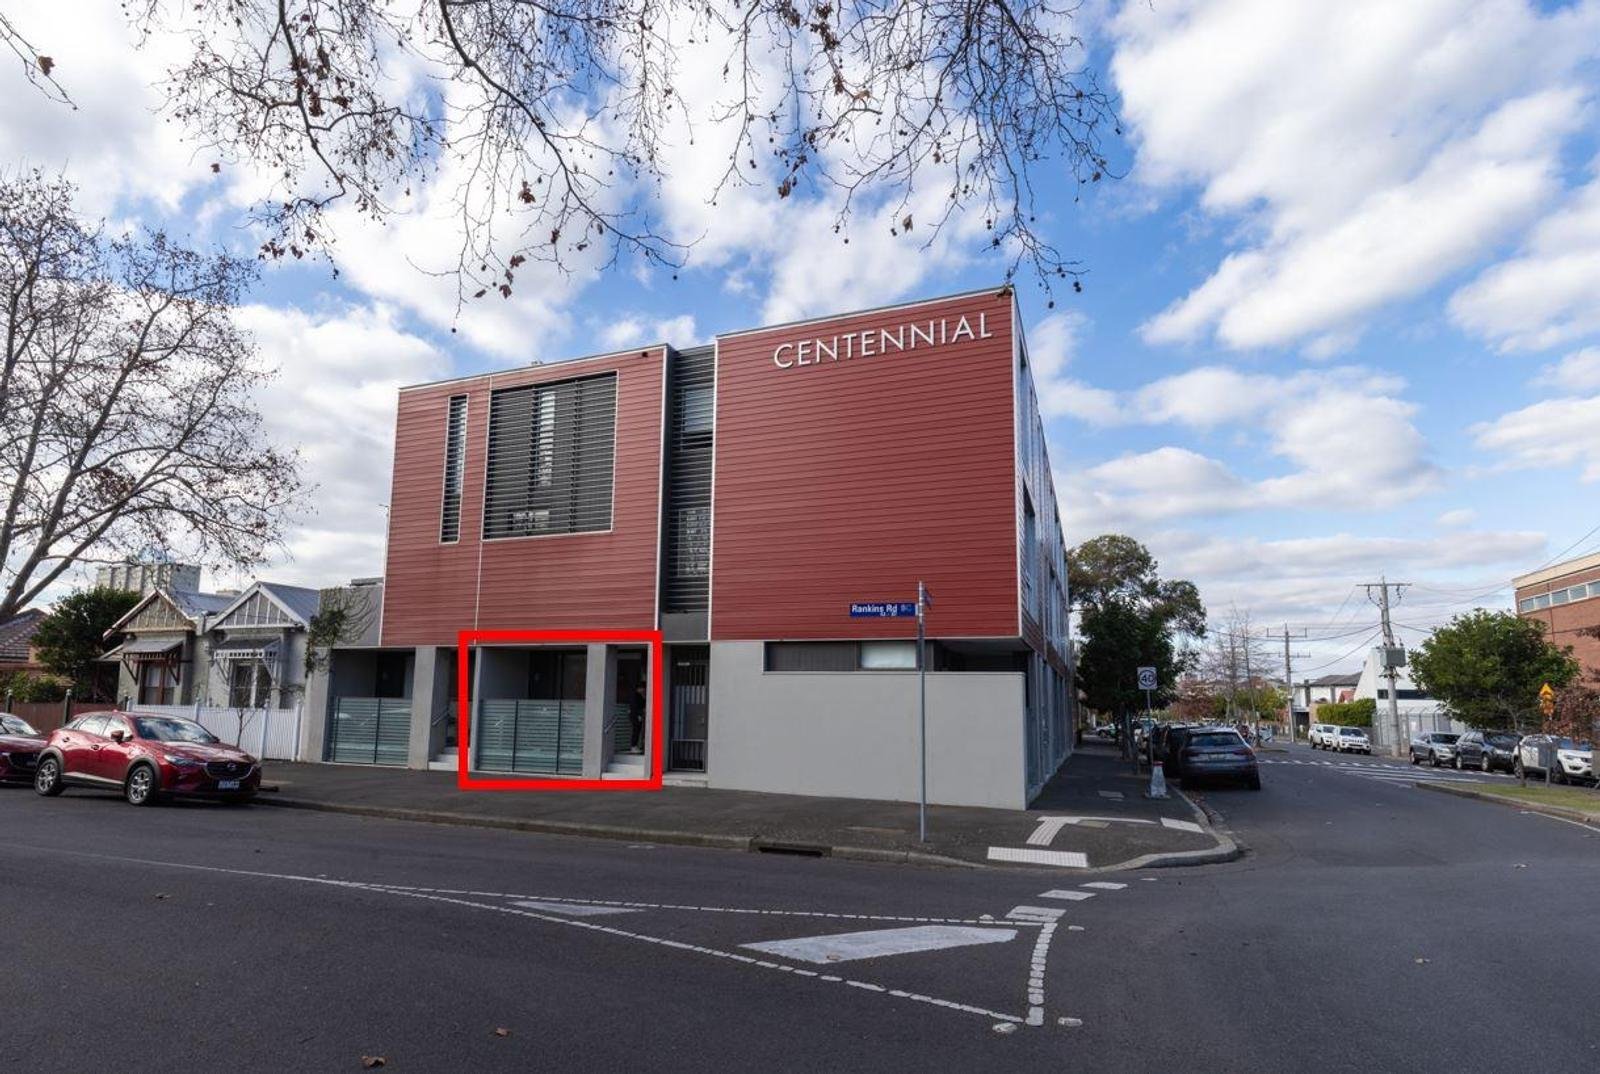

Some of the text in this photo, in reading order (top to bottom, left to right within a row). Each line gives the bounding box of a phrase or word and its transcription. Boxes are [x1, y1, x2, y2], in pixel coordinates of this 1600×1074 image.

[774, 312, 993, 369] CENTENNIAL
[851, 604, 885, 613] Rankins
[886, 604, 898, 613] Rd
[1141, 674, 1154, 683] 40
